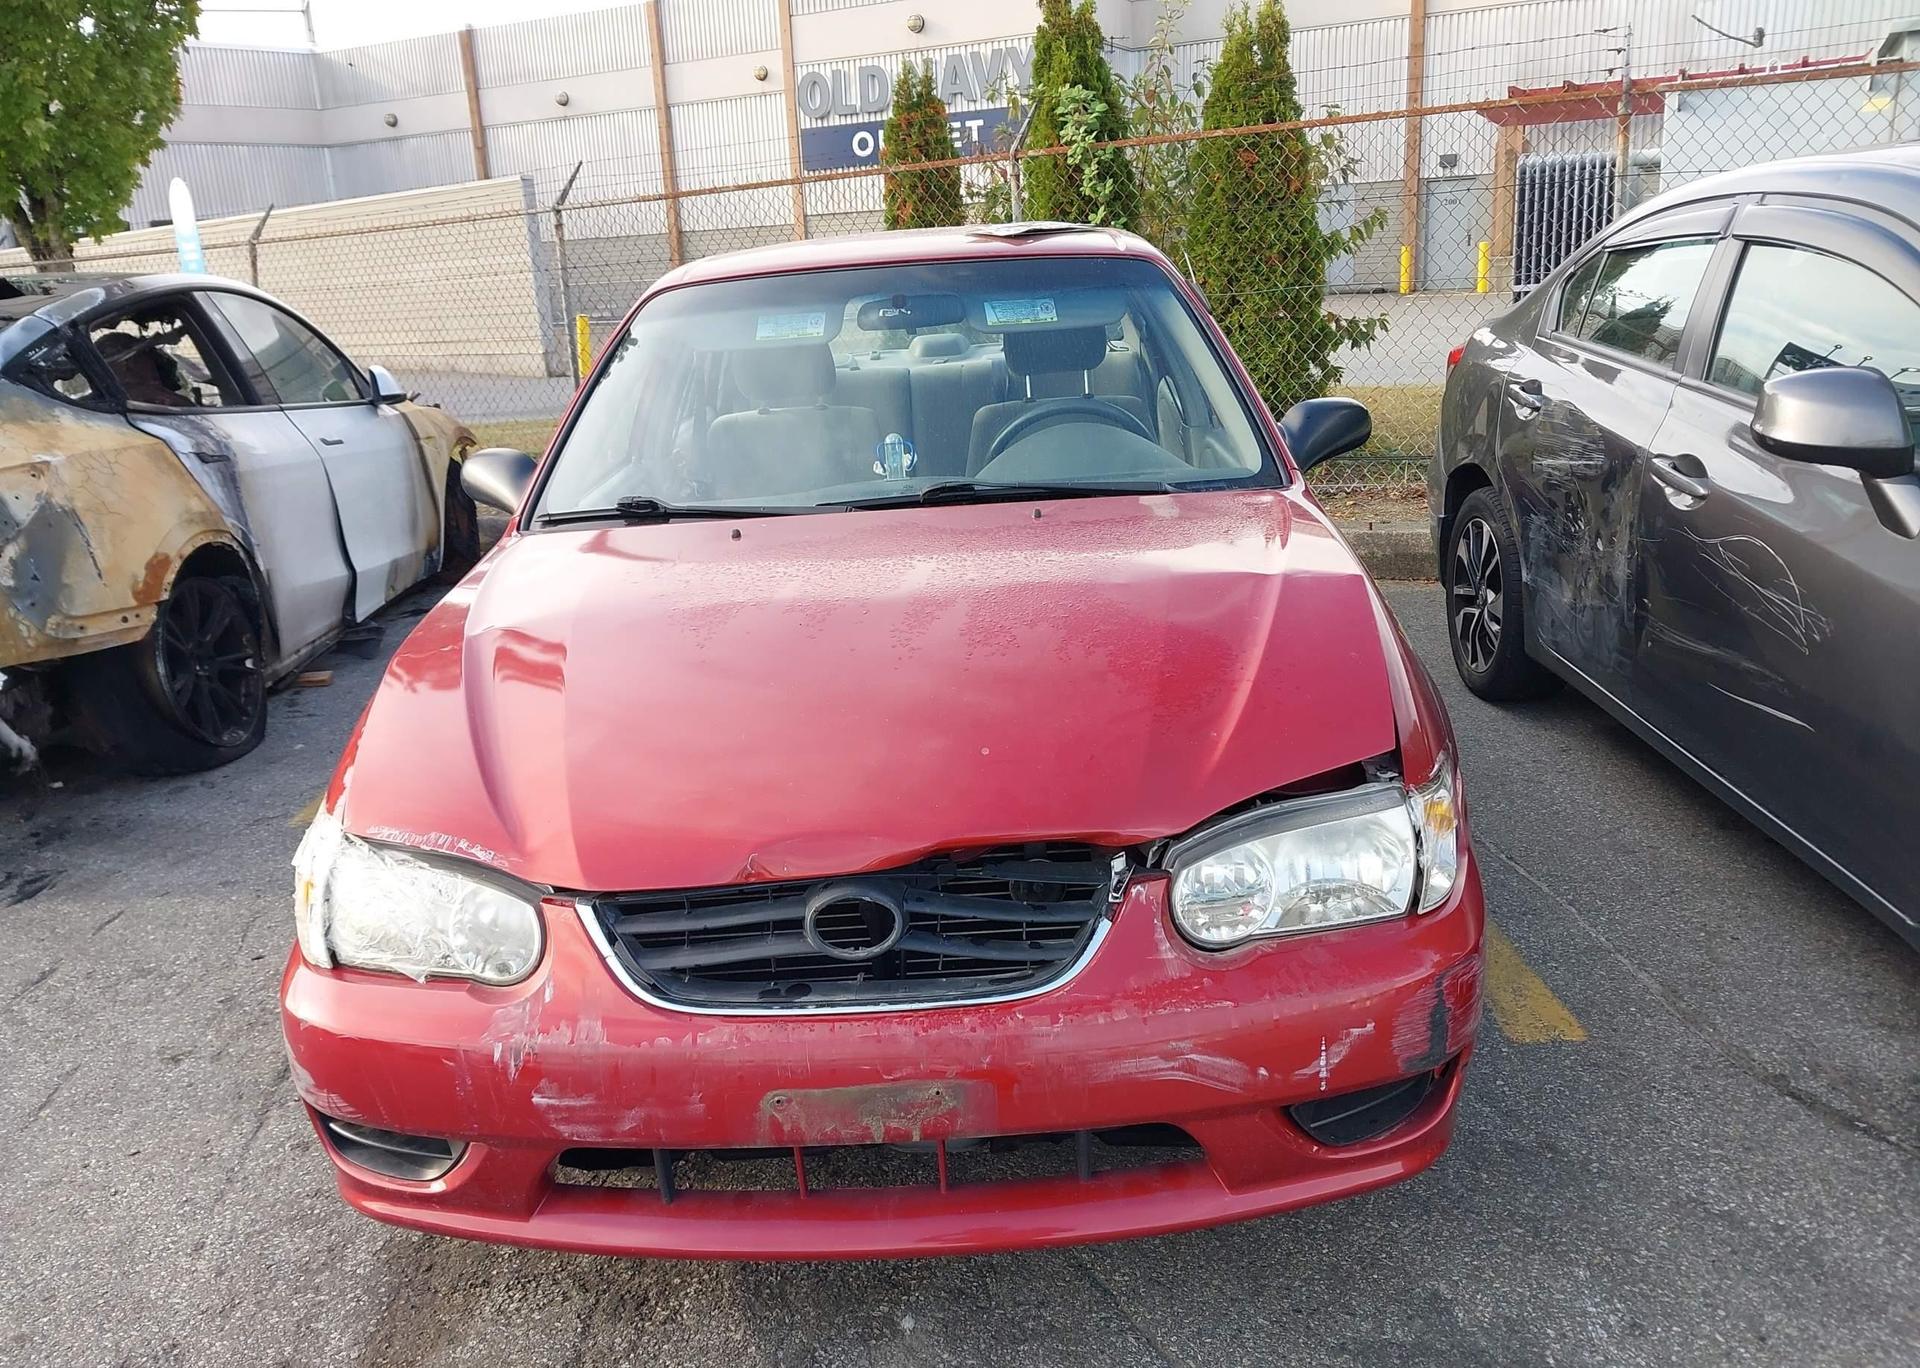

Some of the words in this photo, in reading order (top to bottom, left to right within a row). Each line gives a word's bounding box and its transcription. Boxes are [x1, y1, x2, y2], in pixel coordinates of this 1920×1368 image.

[798, 65, 890, 118] OLD
[852, 119, 984, 157] OET
[1443, 198, 1458, 206] 200
